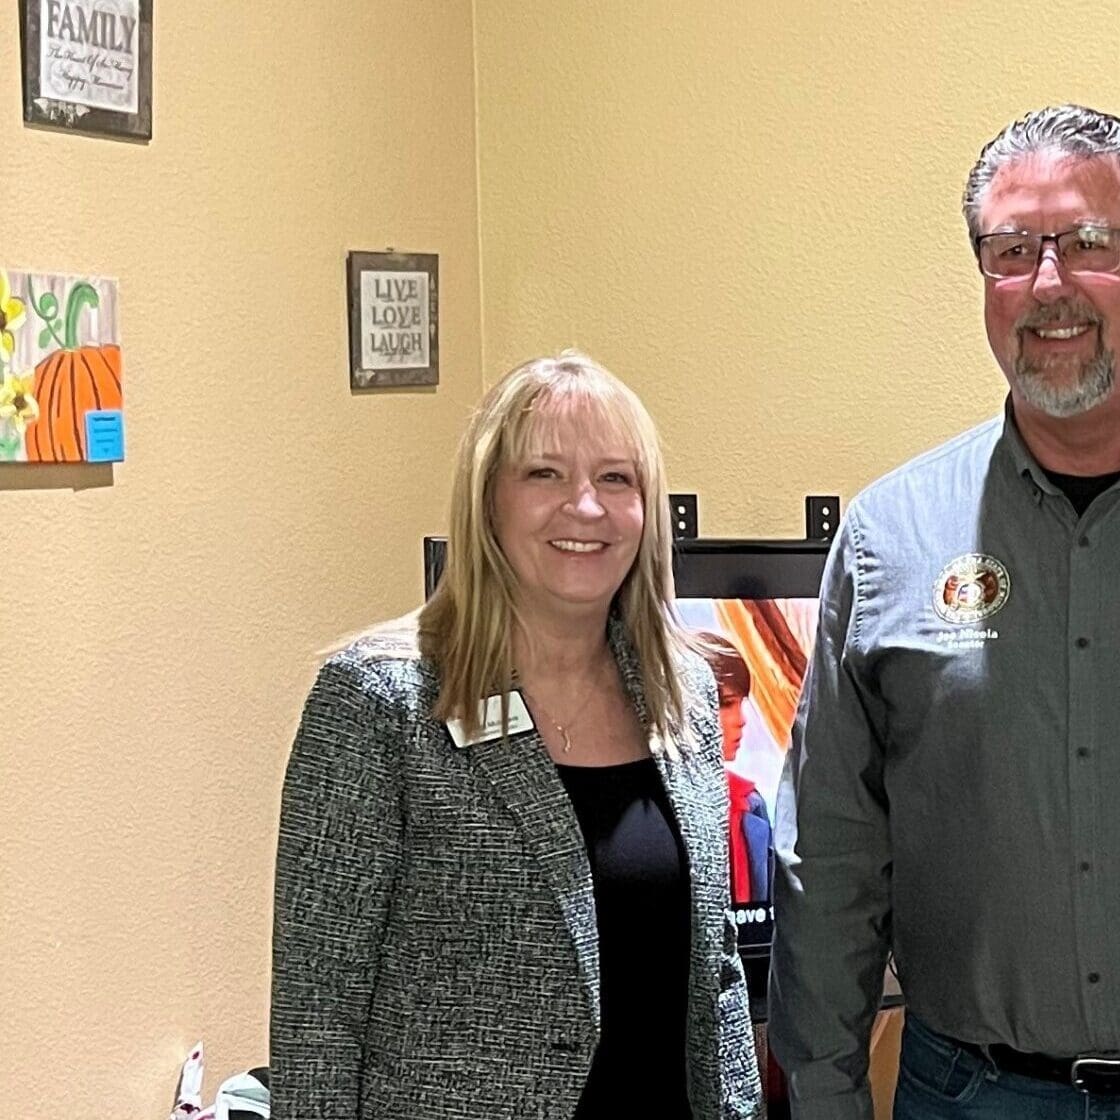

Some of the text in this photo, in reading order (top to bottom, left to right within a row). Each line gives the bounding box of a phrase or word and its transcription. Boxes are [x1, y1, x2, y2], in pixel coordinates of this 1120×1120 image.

[47, 0, 136, 54] FAMILY
[374, 279, 419, 302] LIVE
[371, 305, 423, 329] LOVE
[370, 332, 424, 357] LAUGH
